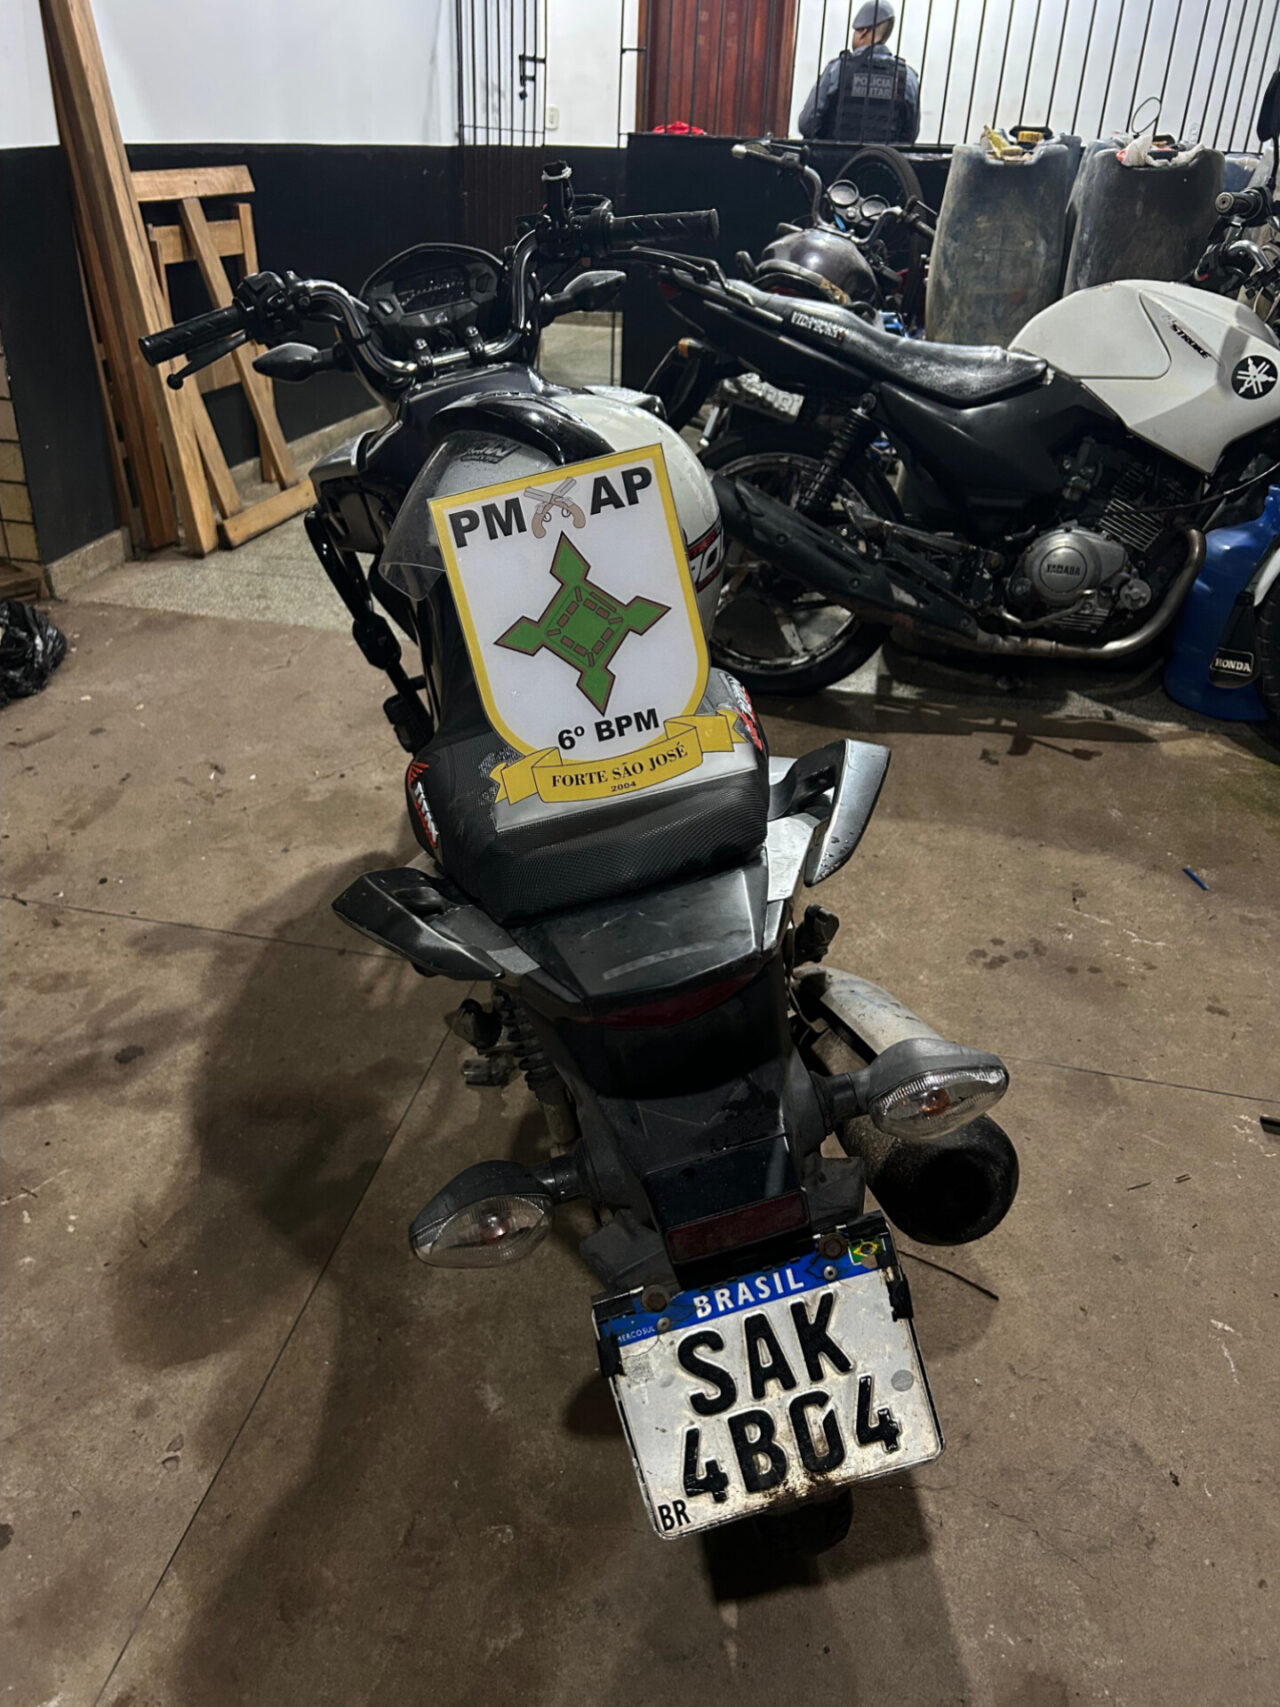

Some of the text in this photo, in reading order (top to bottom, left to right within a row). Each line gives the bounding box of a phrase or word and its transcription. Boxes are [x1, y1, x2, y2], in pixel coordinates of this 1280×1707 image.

[449, 466, 652, 549] PM AP
[1215, 658, 1251, 672] HONDA
[594, 708, 659, 742] BPM
[552, 742, 689, 788] FORTE SÃO JOSÉ
[610, 781, 637, 792] 2004
[693, 1267, 804, 1319] BRASIL
[677, 1291, 853, 1416] SAK
[658, 1499, 691, 1531] BR
